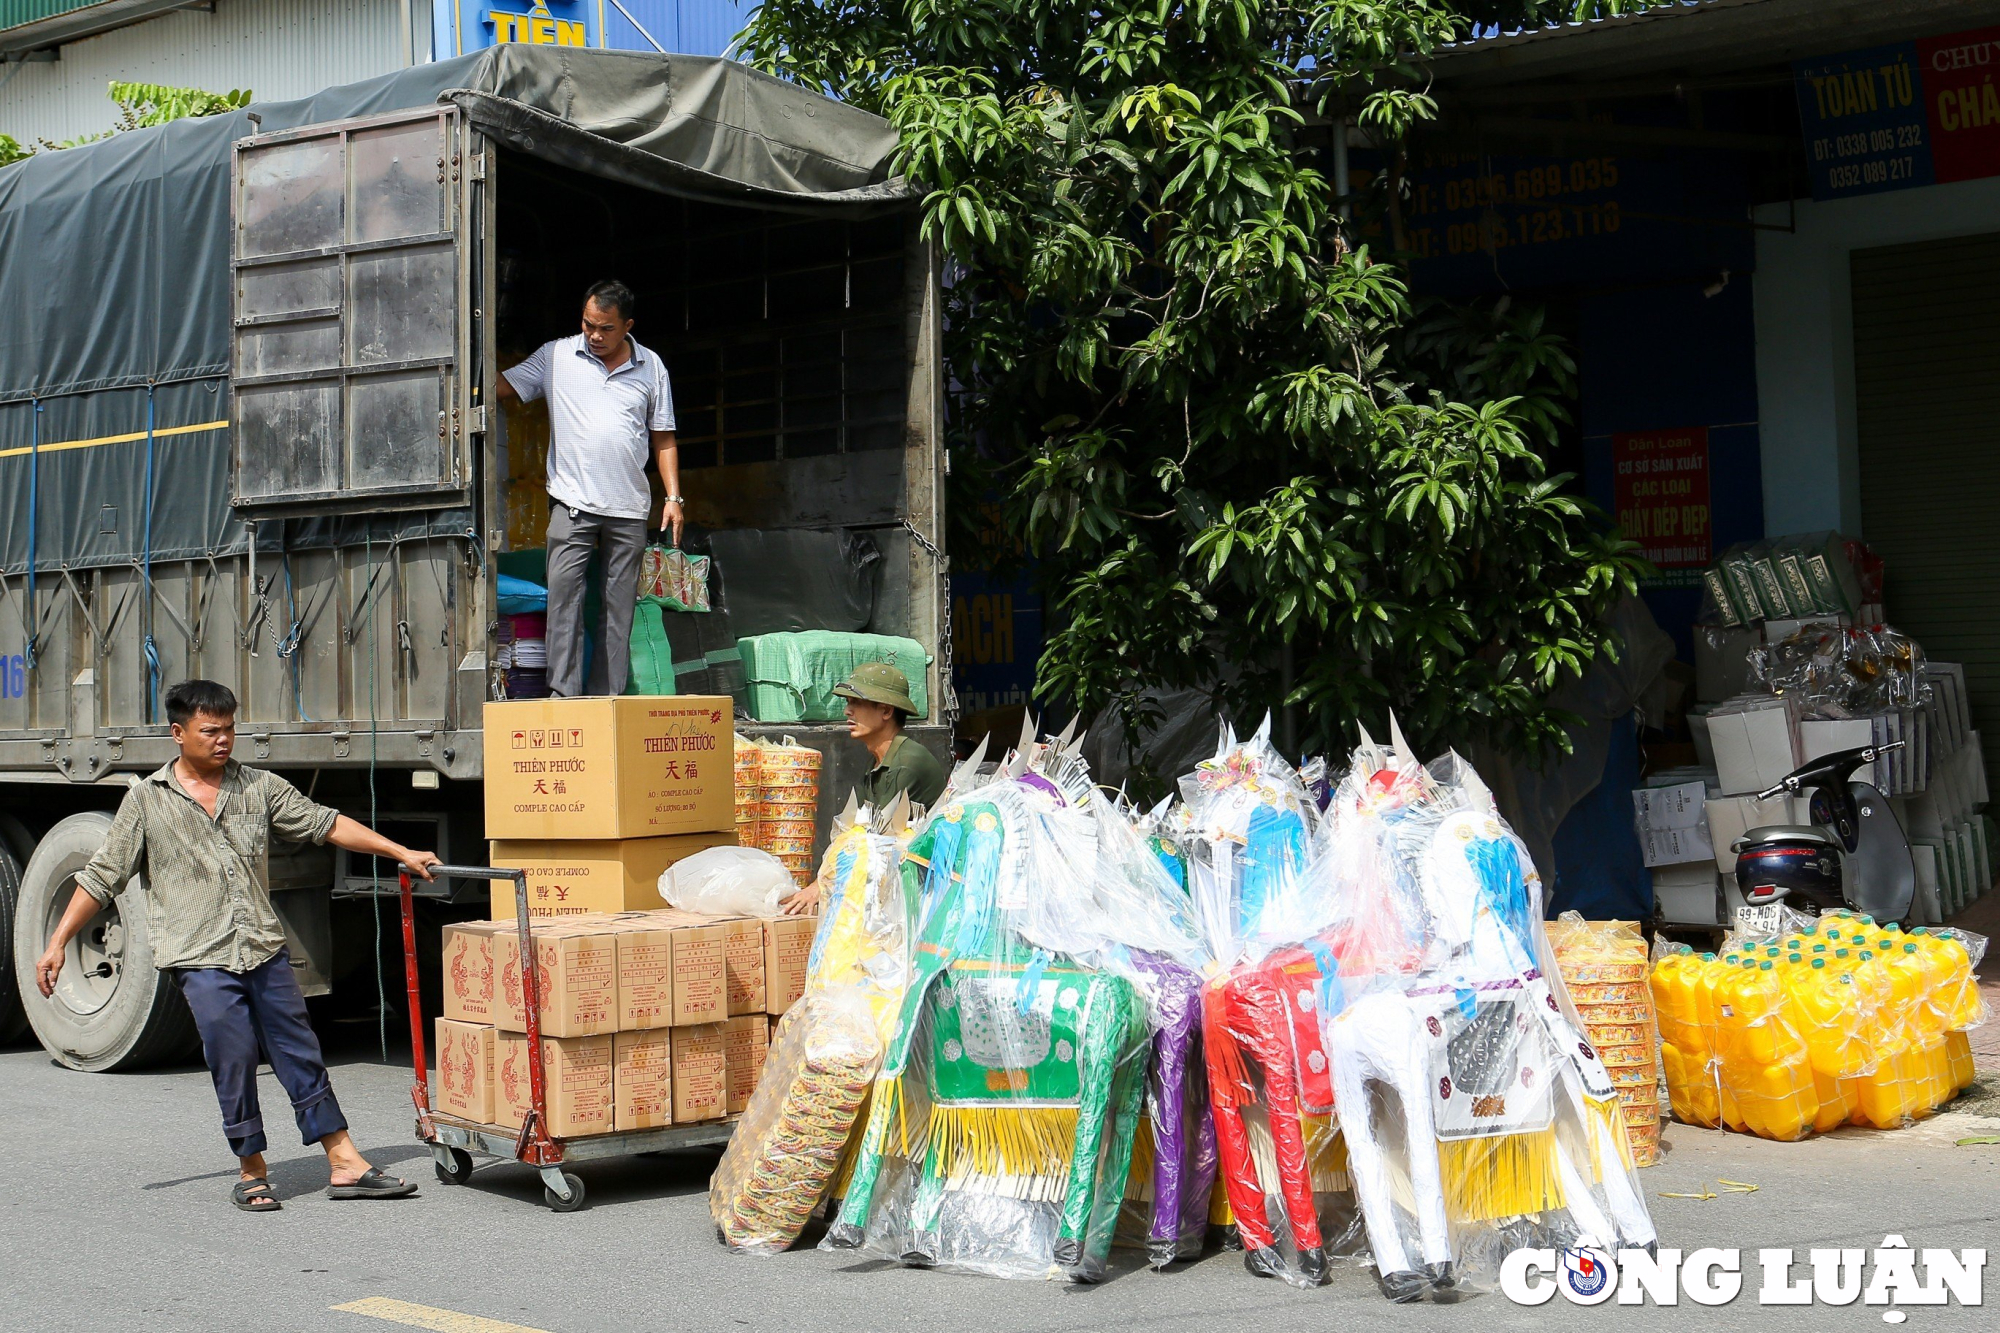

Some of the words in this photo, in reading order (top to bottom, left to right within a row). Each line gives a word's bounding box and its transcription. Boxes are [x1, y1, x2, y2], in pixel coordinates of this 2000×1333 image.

[1812, 63, 1878, 120] TOÀN
[1880, 52, 1914, 110] TÚ
[1937, 73, 2000, 132] CHÁ
[1836, 131, 1868, 158] 0338
[1870, 128, 1895, 153] 005
[1897, 124, 1922, 149] 232
[1829, 164, 1861, 189] 0352
[1862, 160, 1888, 184] 089
[1890, 156, 1913, 181] 217
[1658, 436, 1692, 449] Loan
[1618, 459, 1633, 474] CƠ
[1635, 454, 1650, 474] SỞ
[1652, 453, 1674, 473] SẢN
[1676, 451, 1704, 471] XUẤT
[1632, 478, 1659, 497] CÁC
[1662, 479, 1692, 498] LOẠI
[1653, 500, 1679, 537] DÉP
[1681, 504, 1709, 542] ĐẸP
[644, 733, 679, 753] THIÊN
[681, 732, 716, 751] PHƯỚC
[513, 757, 546, 773] THIÊN
[549, 756, 585, 773] PHƯỚC
[513, 803, 547, 813] COMPLE
[549, 803, 567, 812] CAO
[568, 800, 585, 812] CẤP
[536, 867, 554, 877] CAO
[555, 867, 590, 877] COMPLE
